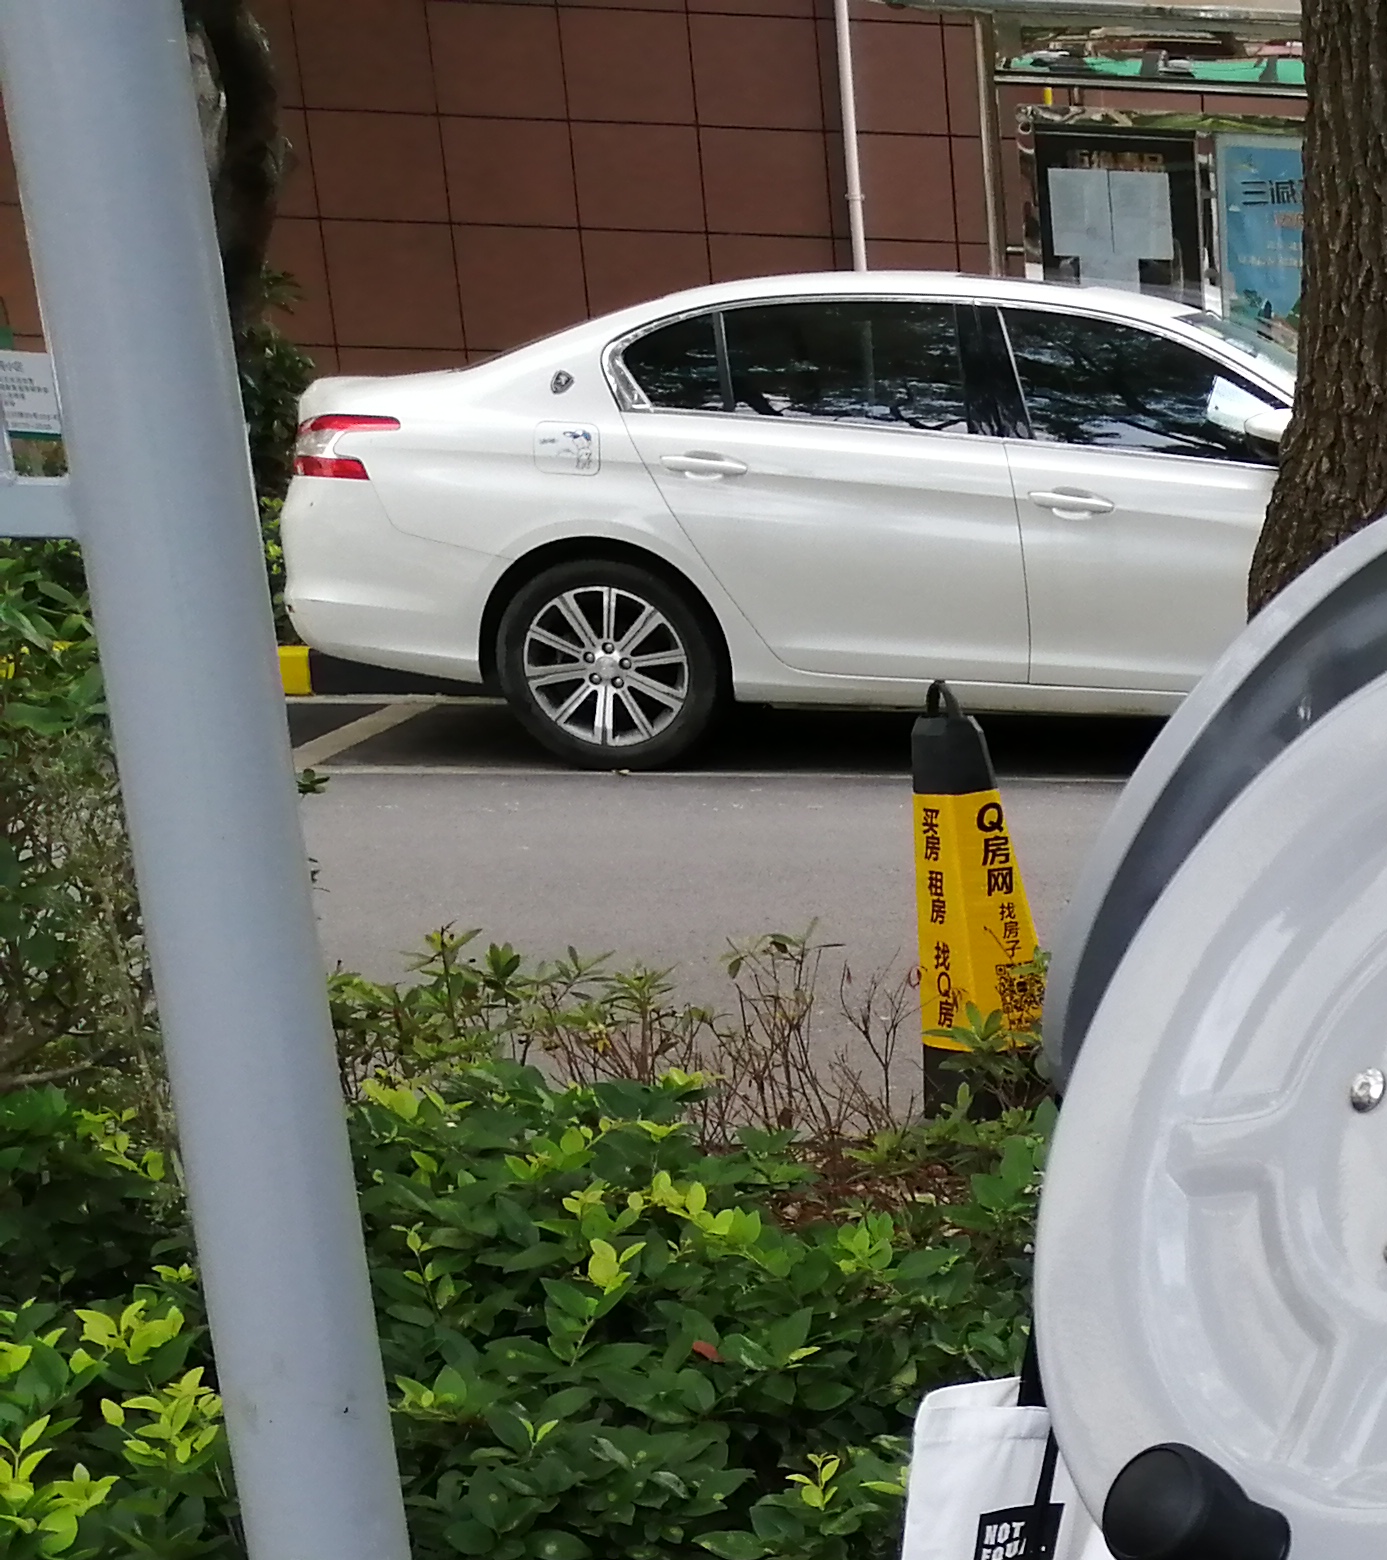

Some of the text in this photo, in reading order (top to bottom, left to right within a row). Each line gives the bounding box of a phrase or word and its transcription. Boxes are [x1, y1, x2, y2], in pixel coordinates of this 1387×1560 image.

[1241, 179, 1303, 205] 三减
[922, 807, 941, 862] 买房
[976, 802, 1014, 897] Q房网
[928, 870, 946, 925] 租房
[999, 902, 1022, 959] 找房子
[983, 1520, 1026, 1546] NOT
